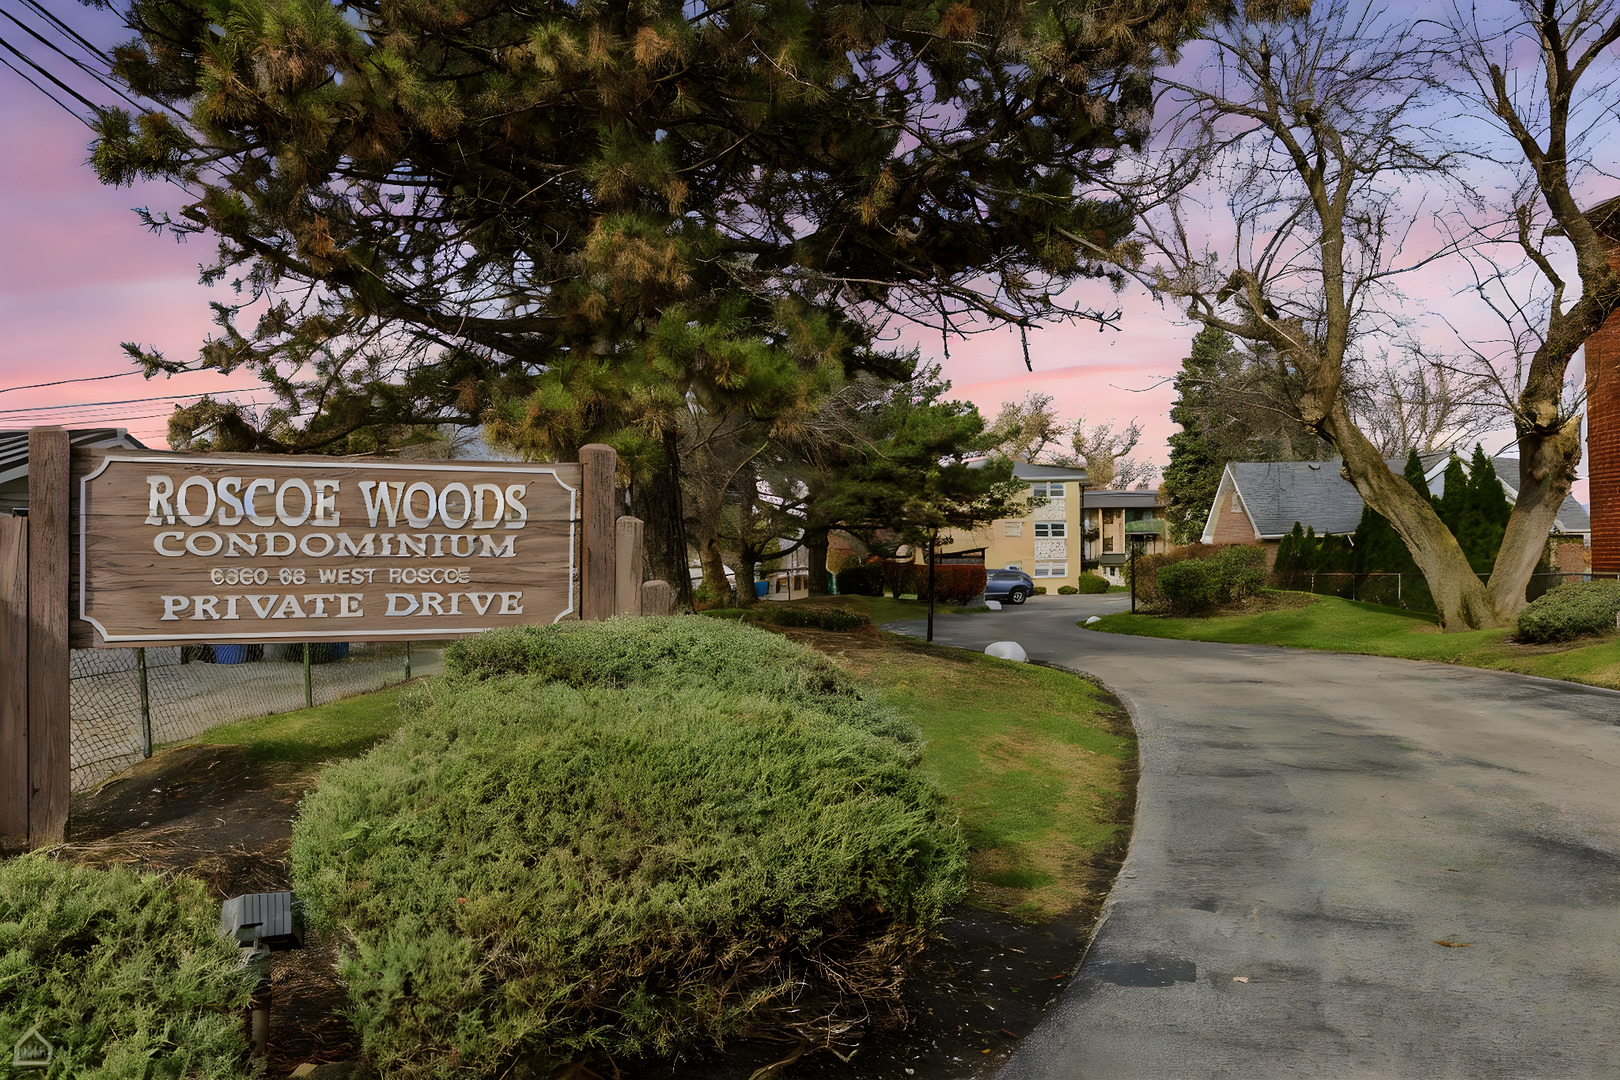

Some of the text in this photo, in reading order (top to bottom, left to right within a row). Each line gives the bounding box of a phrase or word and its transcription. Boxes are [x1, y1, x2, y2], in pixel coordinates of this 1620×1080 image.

[145, 475, 529, 530] ROSCOE WOODS
[153, 531, 518, 558] CONDOMINIUM
[319, 567, 375, 584] WEST
[389, 567, 471, 584] ROSCOE
[160, 591, 525, 621] PRIVATE DRIVE
